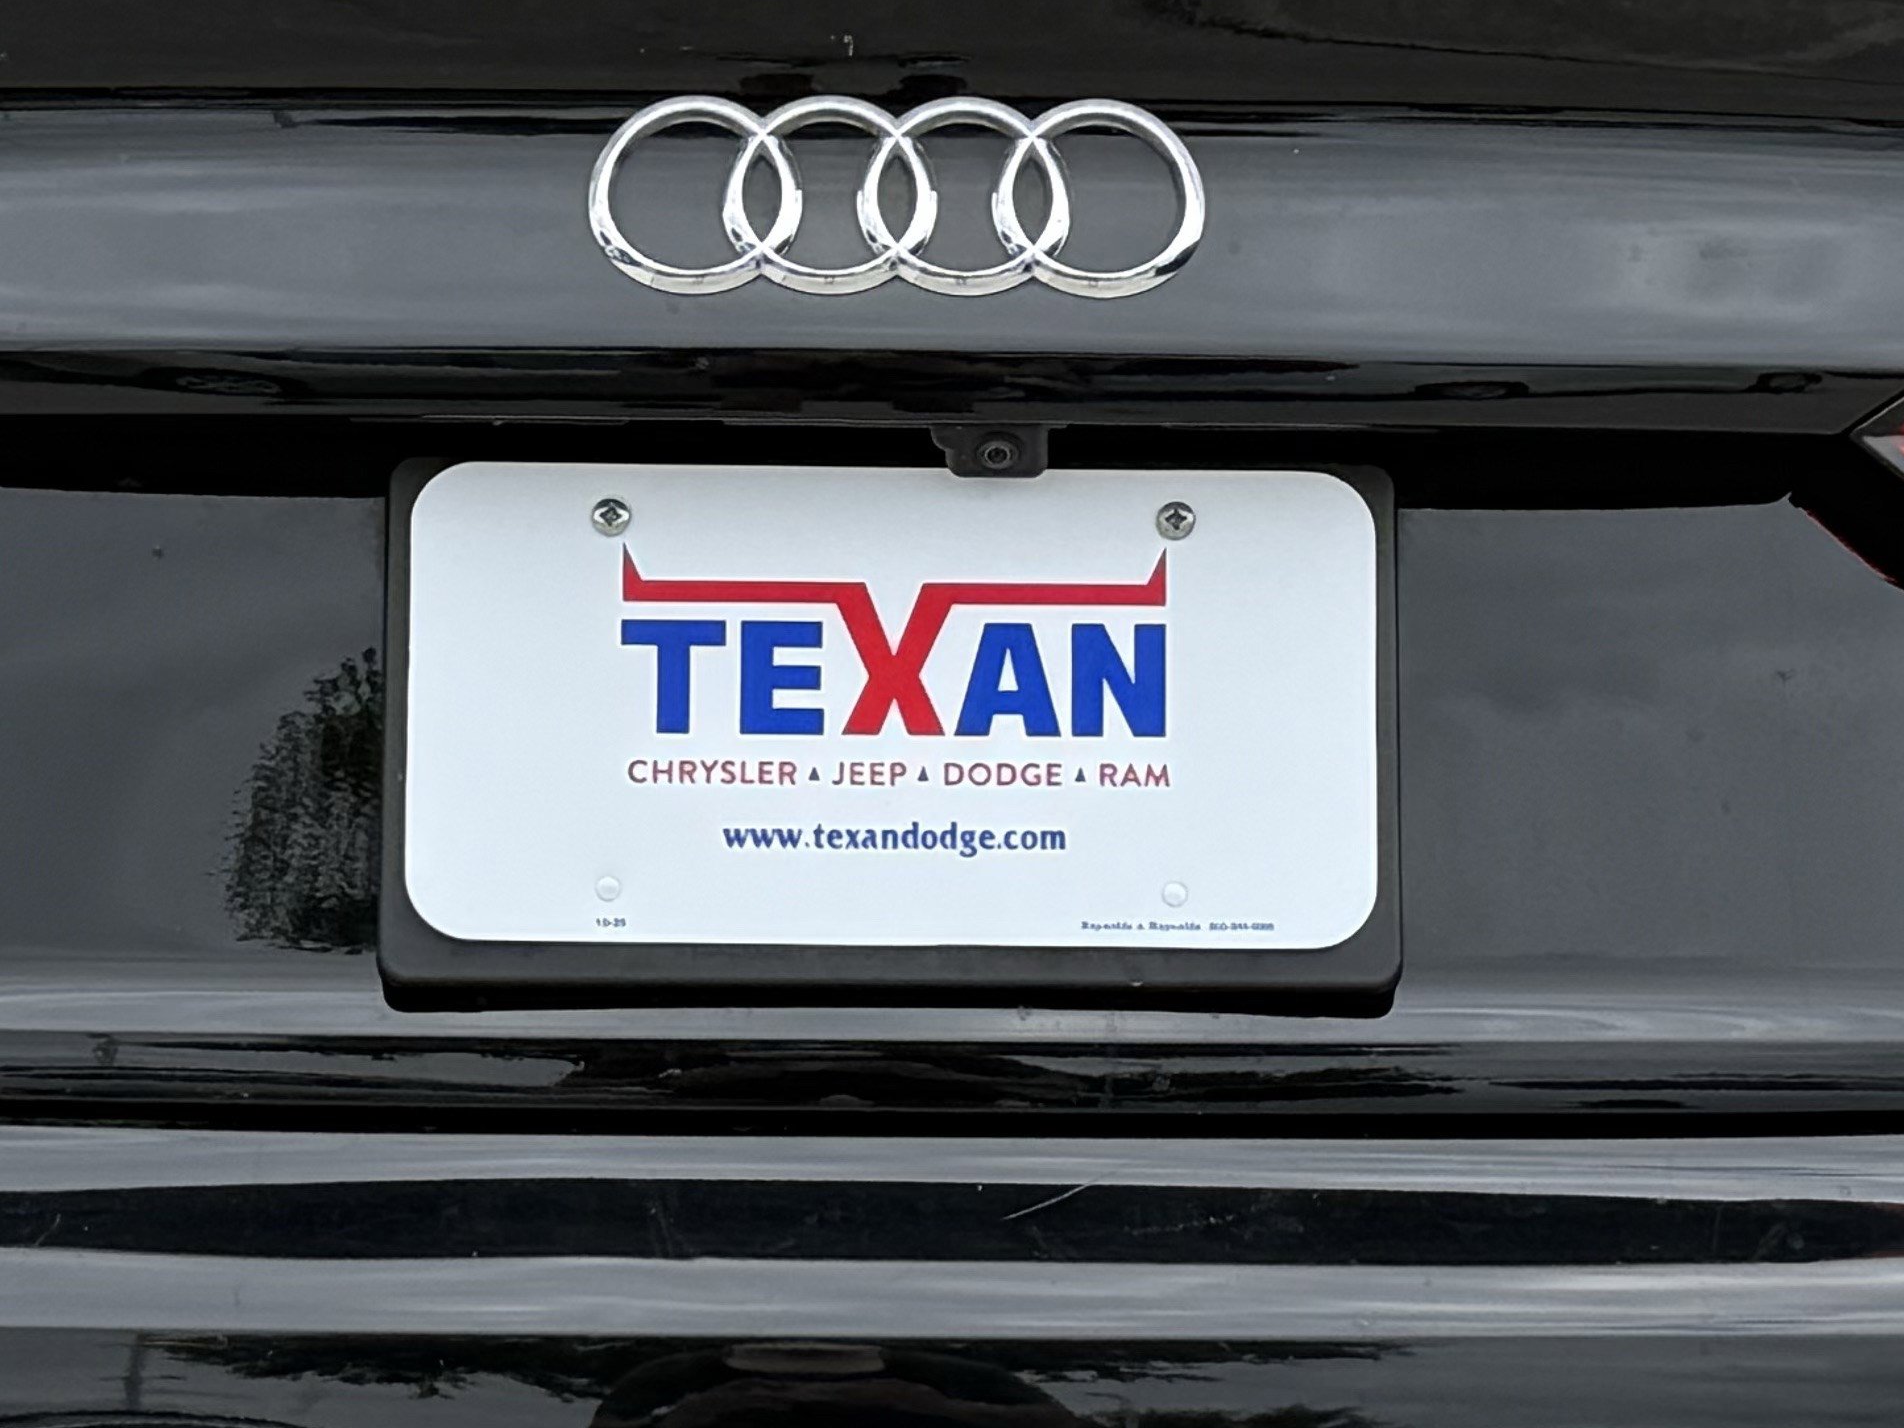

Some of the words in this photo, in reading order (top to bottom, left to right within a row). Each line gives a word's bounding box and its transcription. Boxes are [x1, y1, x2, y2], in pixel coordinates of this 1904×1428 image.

[620, 582, 1167, 737] TEXAN
[627, 758, 797, 786] CHRYSLER
[831, 761, 907, 786] JEEP
[943, 762, 1063, 788] DODGE
[1099, 763, 1171, 788] RAM
[722, 821, 1068, 858] www.texandodge.com
